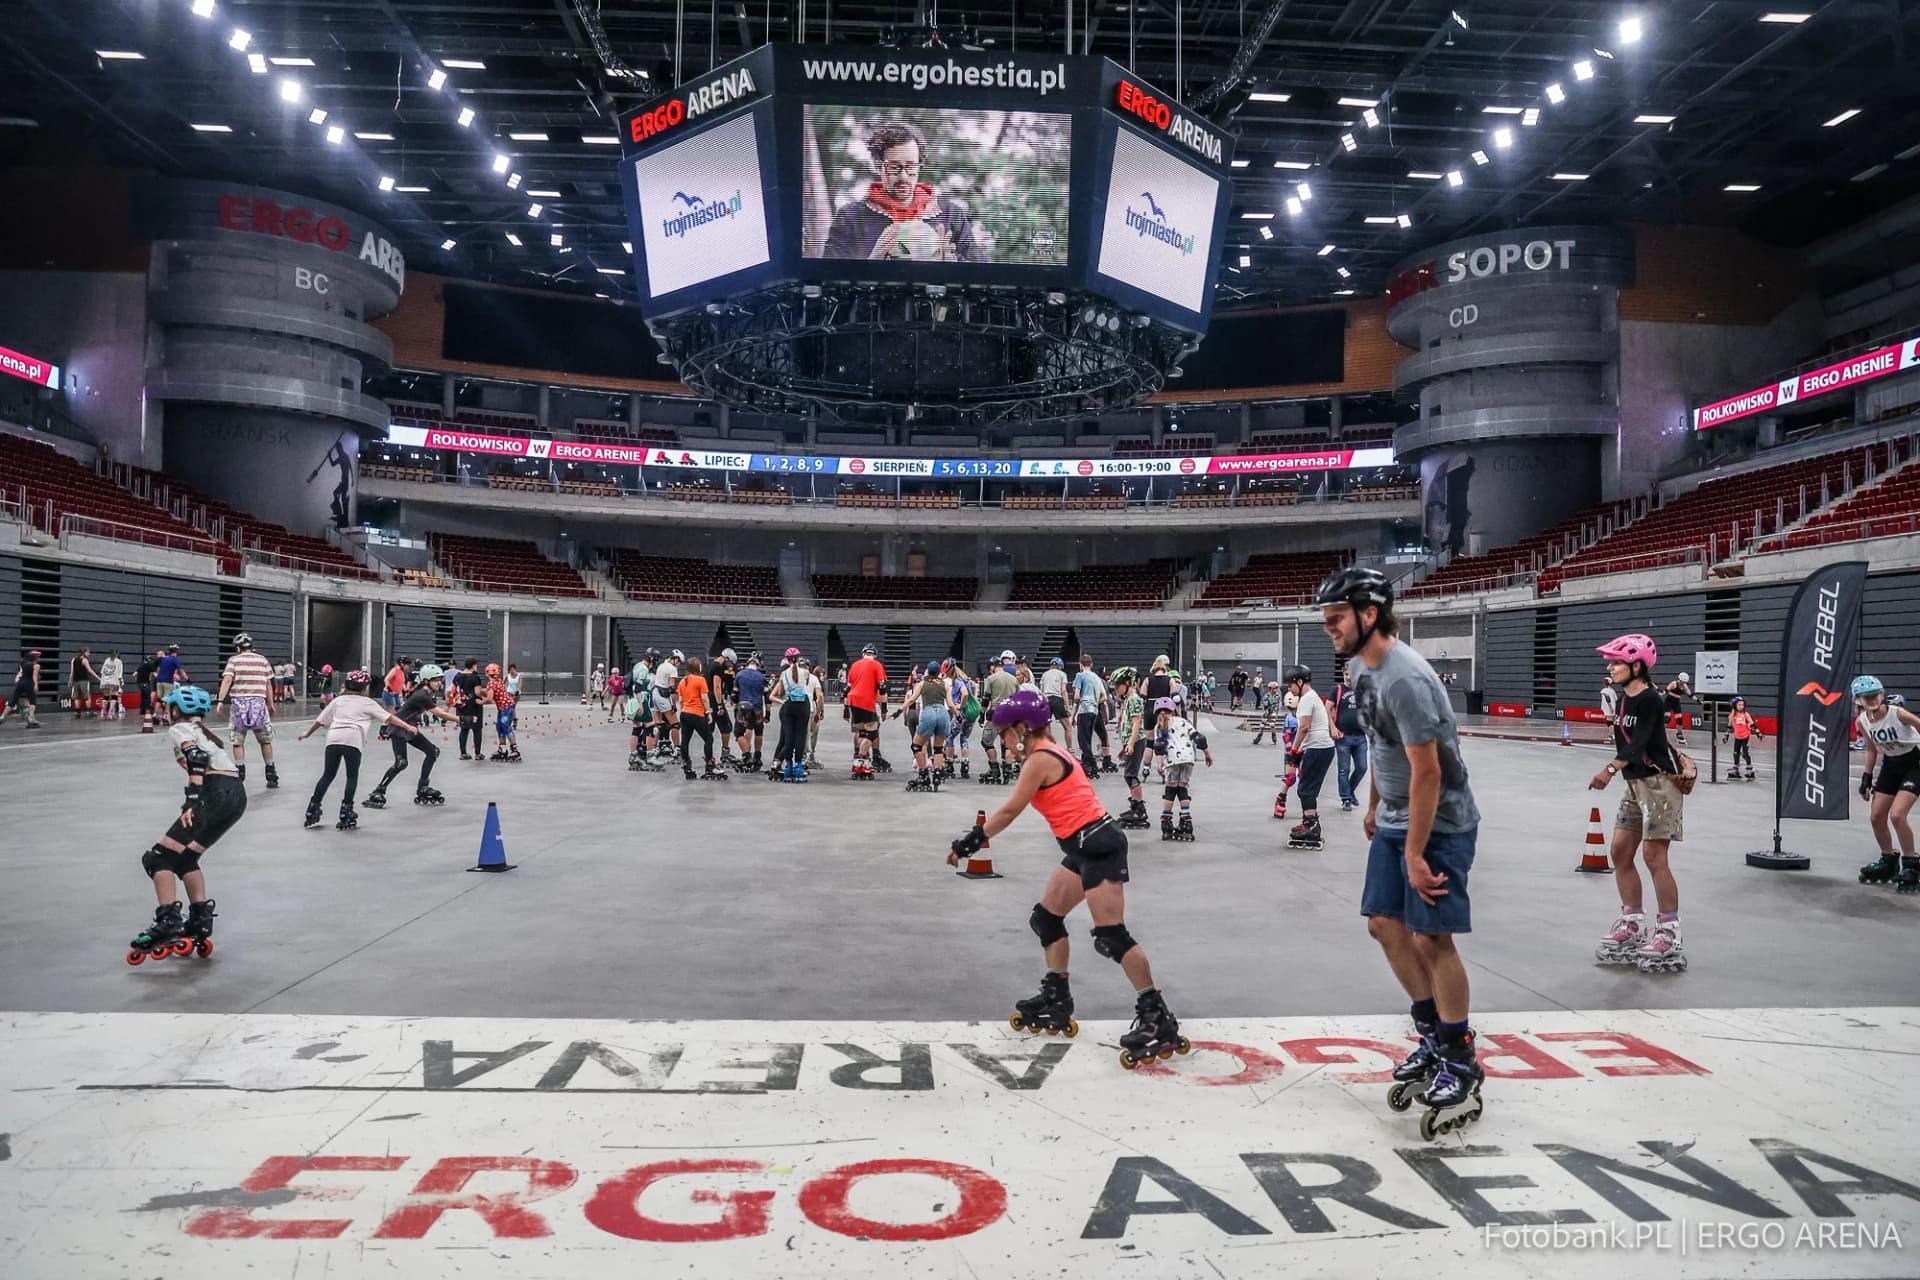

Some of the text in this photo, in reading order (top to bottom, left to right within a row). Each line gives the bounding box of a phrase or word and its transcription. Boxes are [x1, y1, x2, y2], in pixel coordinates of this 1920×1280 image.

[803, 58, 1066, 95] www.ergohestia.pl
[630, 68, 757, 143] ERGO ARENA
[1118, 80, 1222, 164] ERGO ARENA
[219, 195, 350, 251] ERGO
[663, 189, 742, 238] trojmiasto.pl
[1125, 205, 1195, 257] trojmiasto.pl
[295, 267, 329, 295] BC
[1448, 240, 1576, 283] SOPOT
[1450, 304, 1479, 328] CD
[1702, 352, 1895, 423] ROLKOWISKO W ERGO ARENIE
[432, 433, 641, 461] ROLKOWISKO W ERGO ARENIE
[704, 455, 745, 468] LIPIEC:
[815, 460, 824, 471] 9
[972, 463, 992, 475] 13,
[995, 463, 1012, 474] 20
[1100, 461, 1172, 473] 16:00-19:00
[1219, 453, 1342, 471] www.ergoarena.pl
[1805, 581, 1840, 808] SPORT REBEL
[422, 1040, 1074, 1092] ARENA
[184, 1137, 1920, 1243] ERGO ARENA
